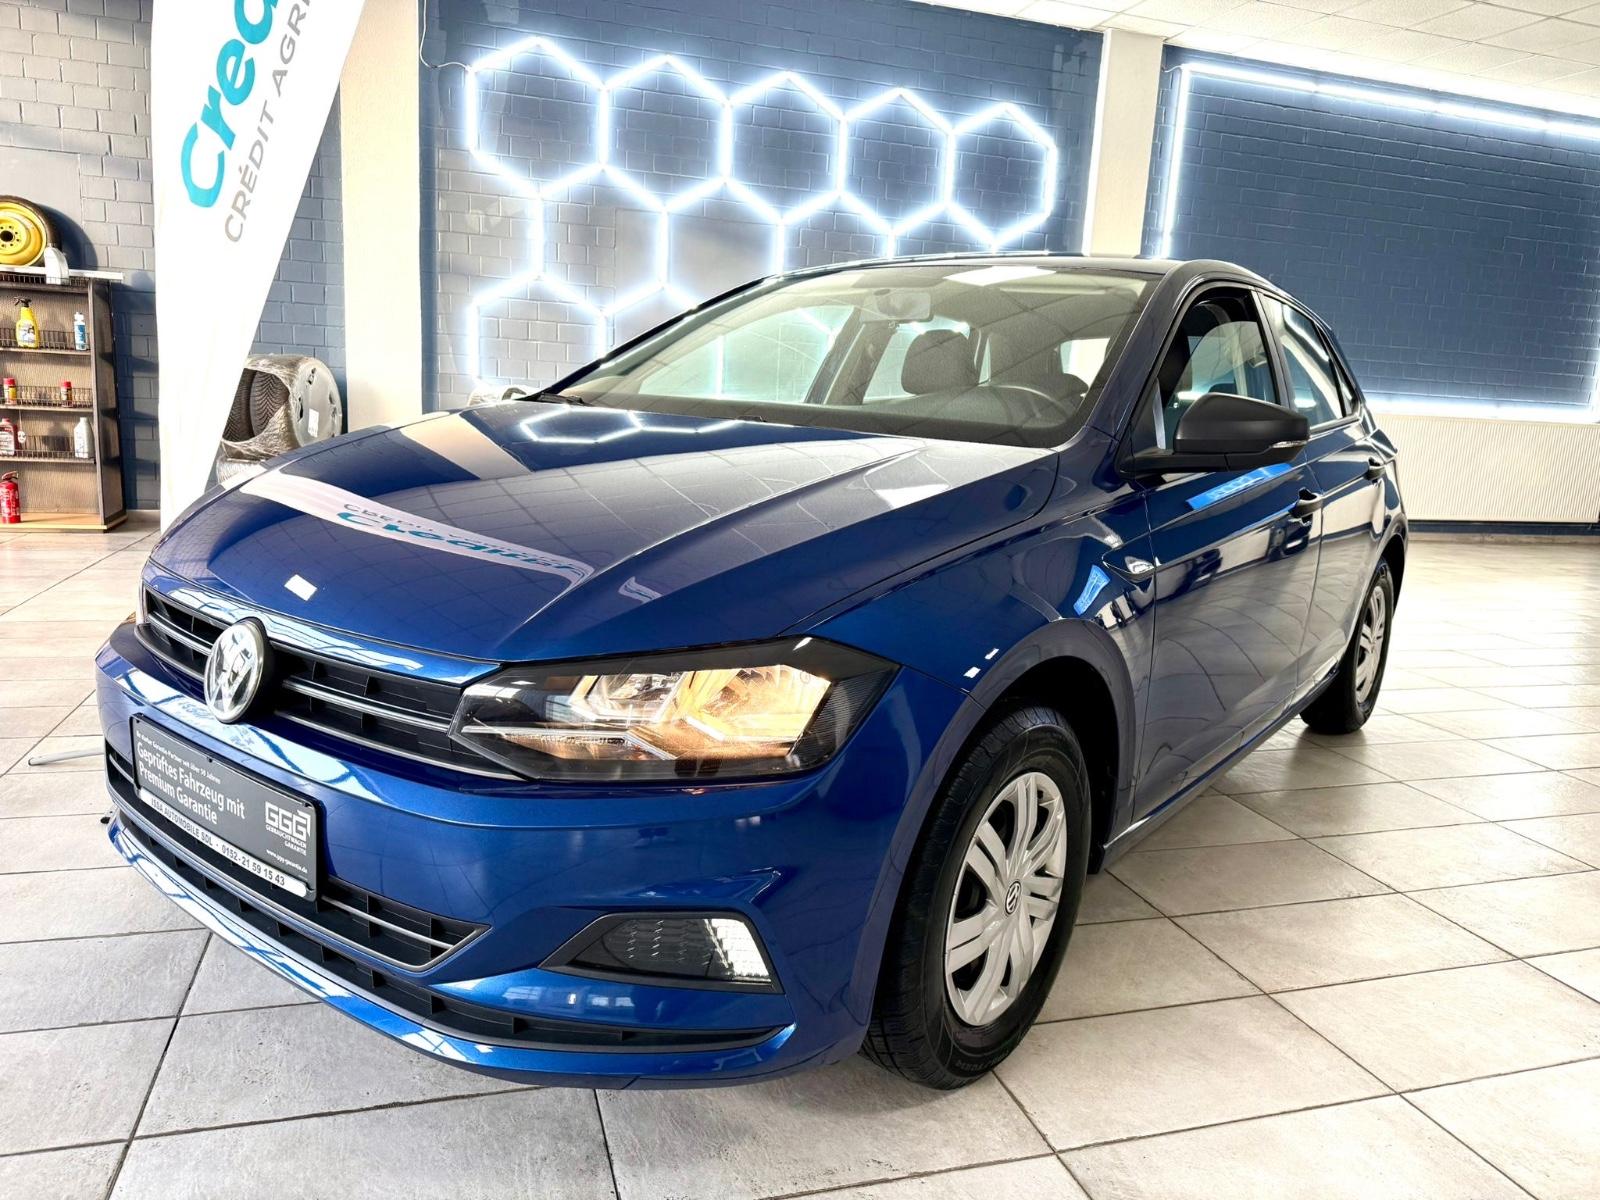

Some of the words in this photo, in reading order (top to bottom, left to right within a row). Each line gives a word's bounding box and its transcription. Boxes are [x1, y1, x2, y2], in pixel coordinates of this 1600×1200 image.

[224, 99, 274, 243] CRÉDIT
[272, 0, 310, 97] AGR
[137, 742, 178, 780] Geprüftes
[179, 766, 225, 811] Fahrzeug
[226, 797, 245, 819] mit
[139, 760, 175, 799] Premium
[176, 786, 217, 825] Garantie
[164, 807, 200, 838] AUTOMOBILE
[252, 862, 261, 874] 59
[264, 868, 273, 880] 15
[275, 874, 285, 886] 43
